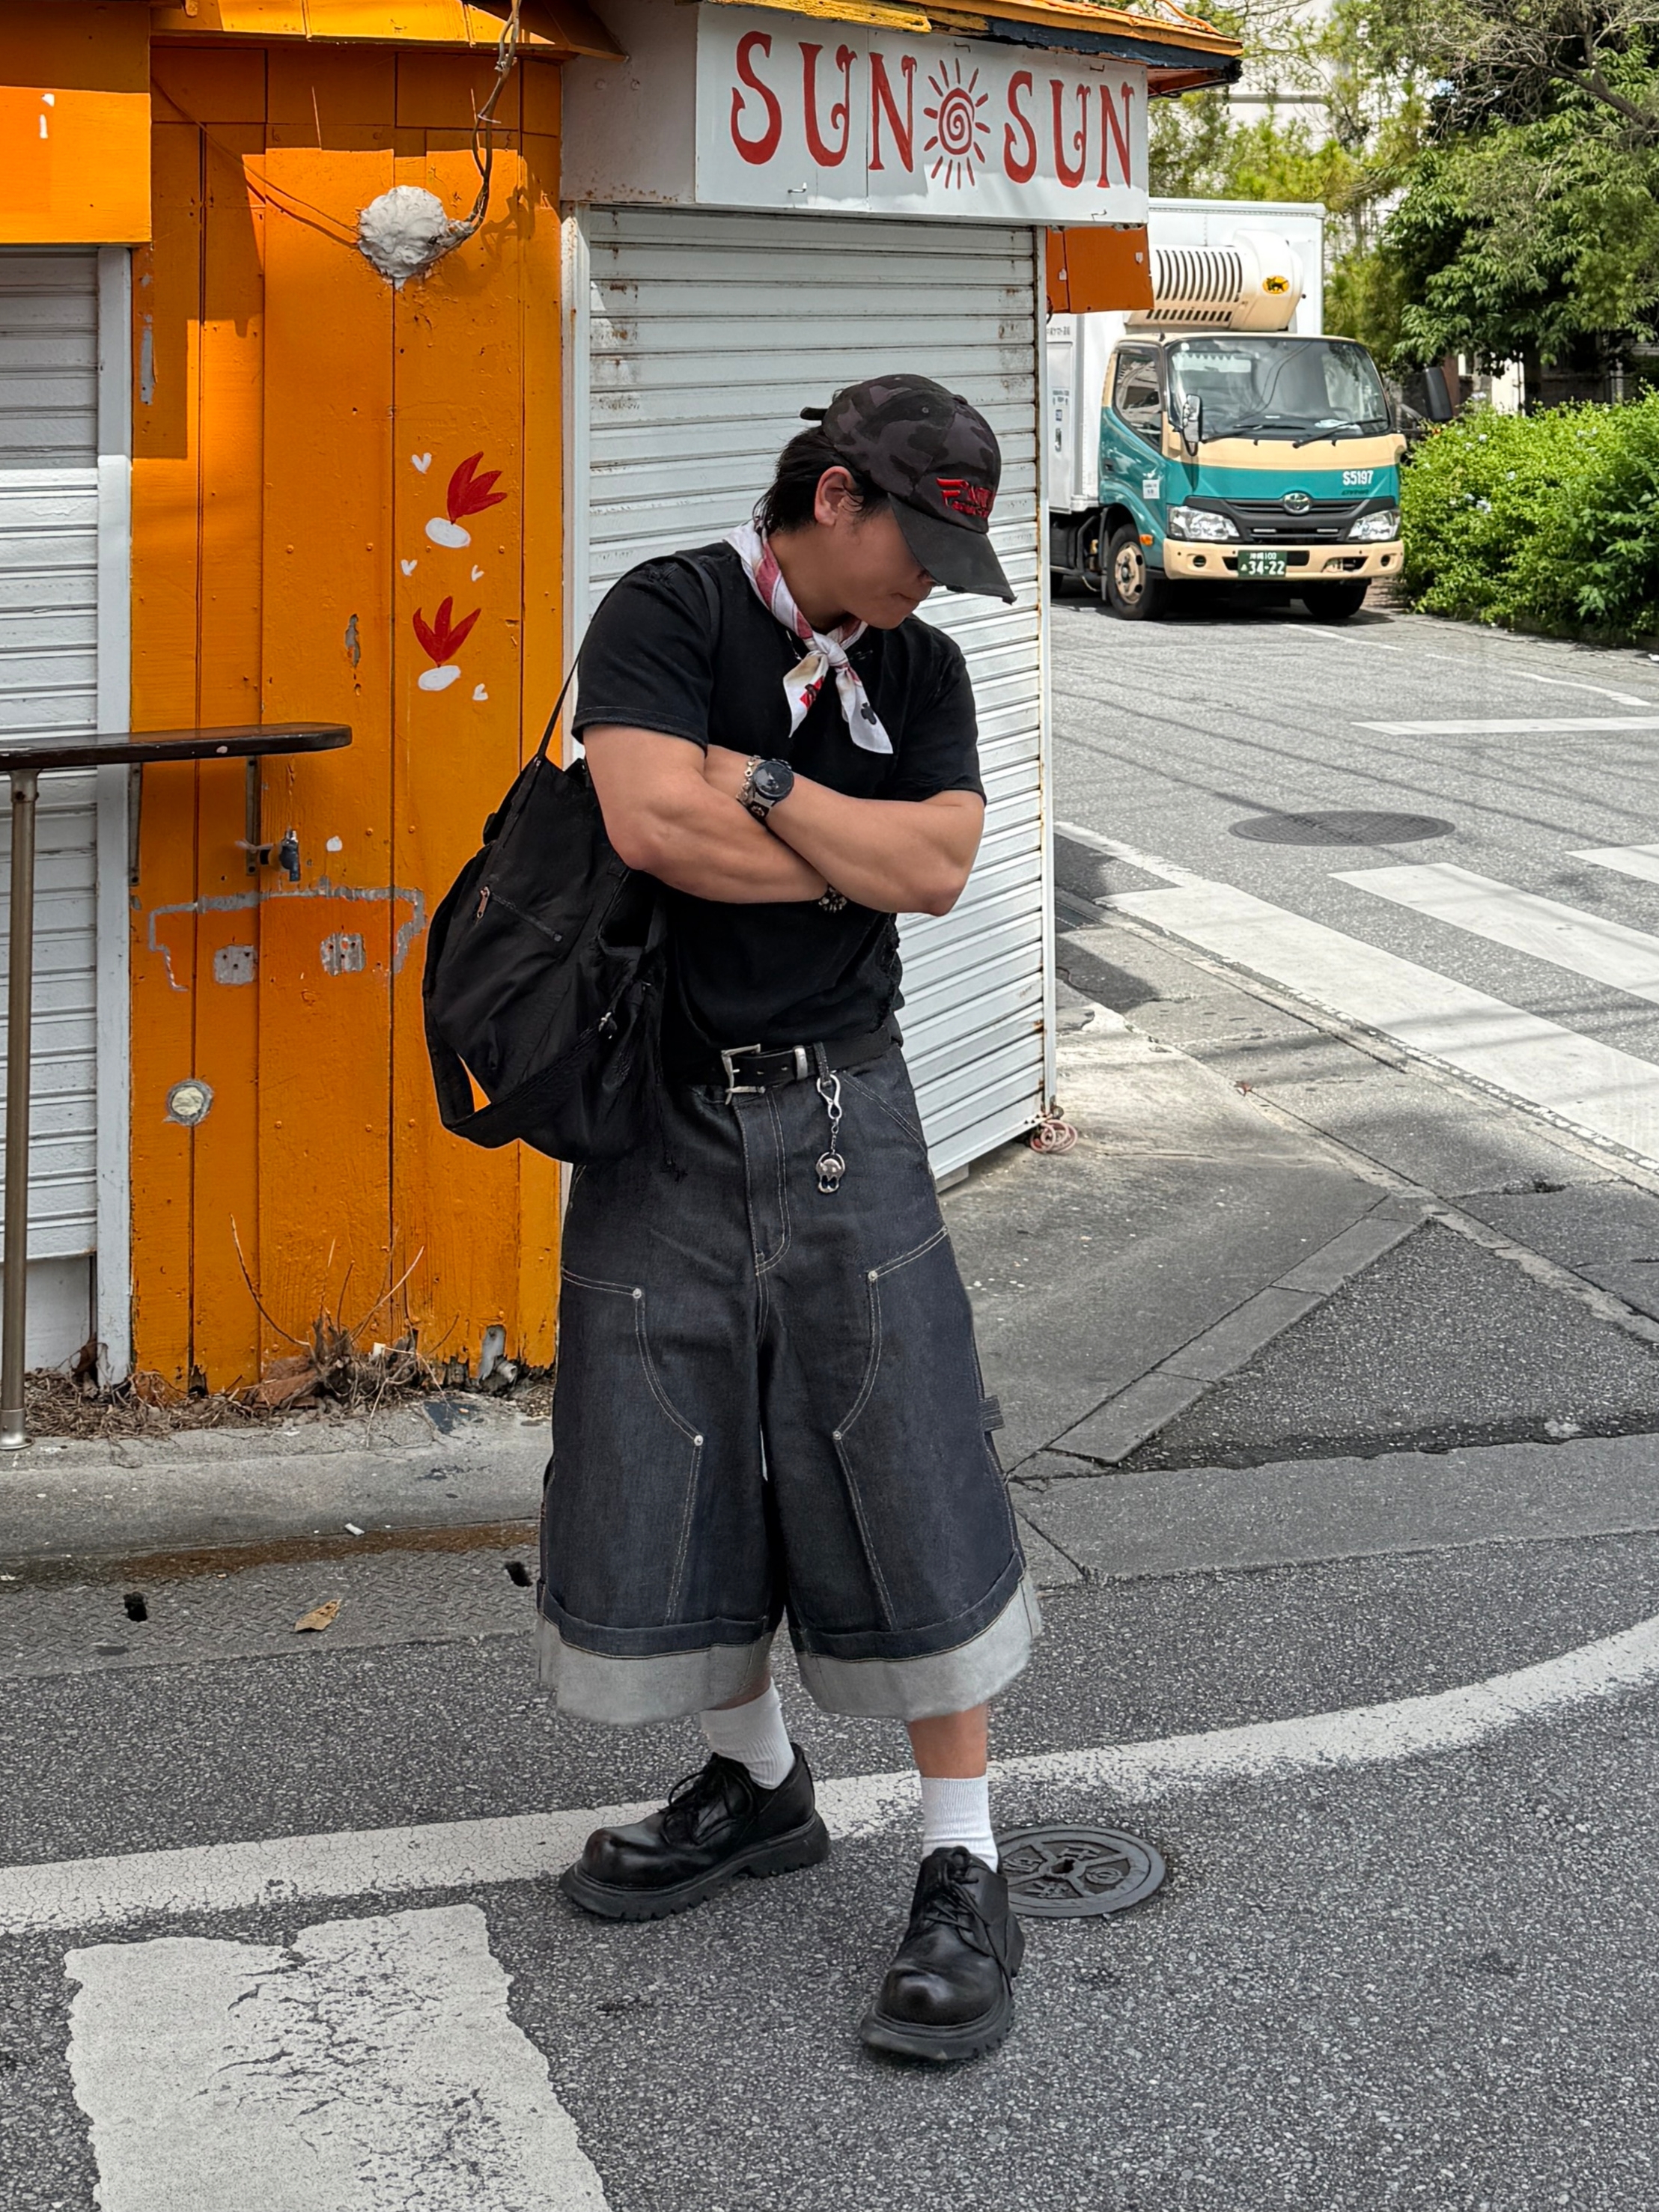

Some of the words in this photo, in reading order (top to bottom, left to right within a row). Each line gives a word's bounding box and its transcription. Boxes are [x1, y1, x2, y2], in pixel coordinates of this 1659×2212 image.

[731, 31, 916, 172] SUN
[1004, 70, 1135, 189] SUN
[1342, 470, 1374, 485] S5197
[1248, 560, 1285, 575] 34-22
